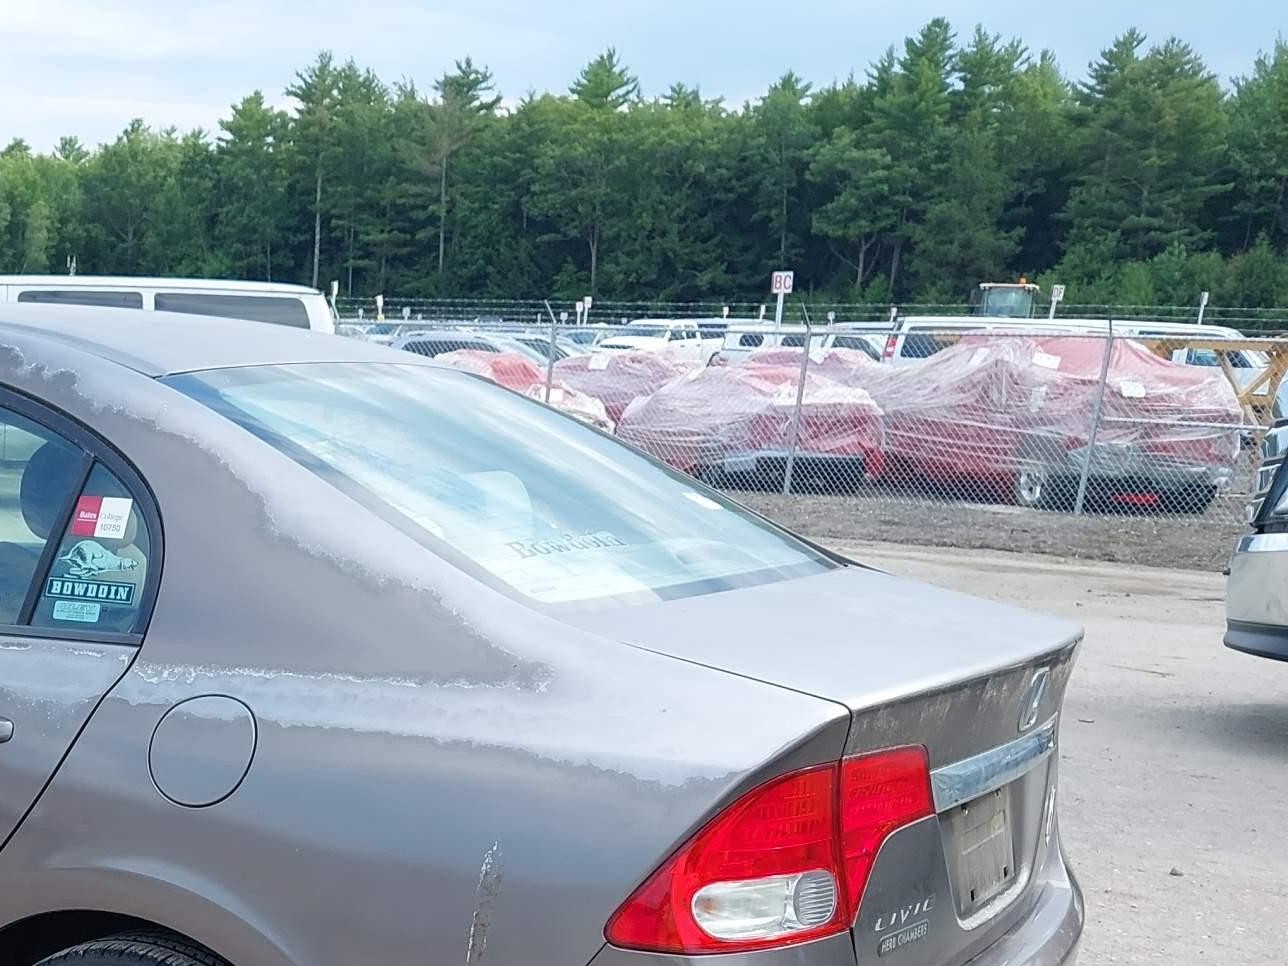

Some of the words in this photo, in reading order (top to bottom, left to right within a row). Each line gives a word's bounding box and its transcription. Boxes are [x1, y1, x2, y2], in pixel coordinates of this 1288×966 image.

[774, 274, 792, 290] BC
[504, 529, 627, 559] Bowdoin
[51, 580, 130, 600] BOWDOIN
[881, 936, 896, 953] HERB
[897, 922, 928, 946] CHAMBERS
